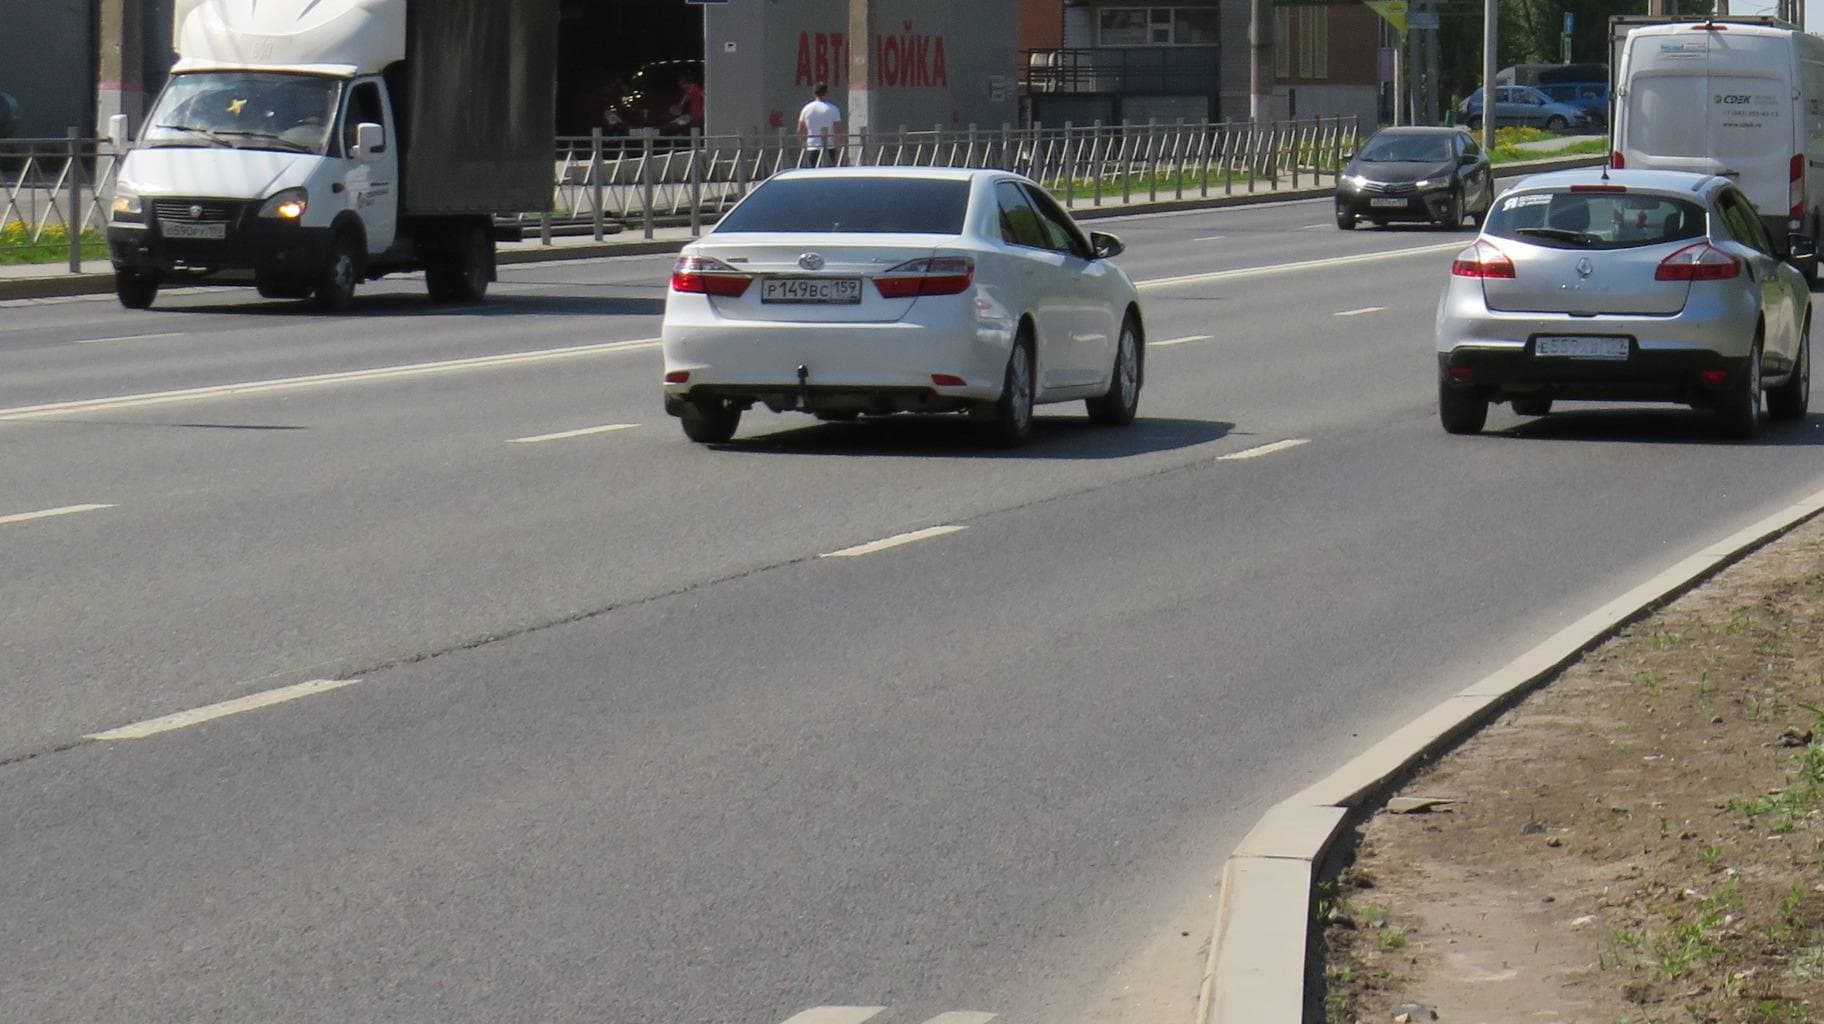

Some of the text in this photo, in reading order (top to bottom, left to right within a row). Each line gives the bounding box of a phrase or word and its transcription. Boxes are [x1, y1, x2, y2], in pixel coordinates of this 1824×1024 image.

[1723, 95, 1752, 104] CDEK
[767, 281, 857, 297] Р149ВС 159
